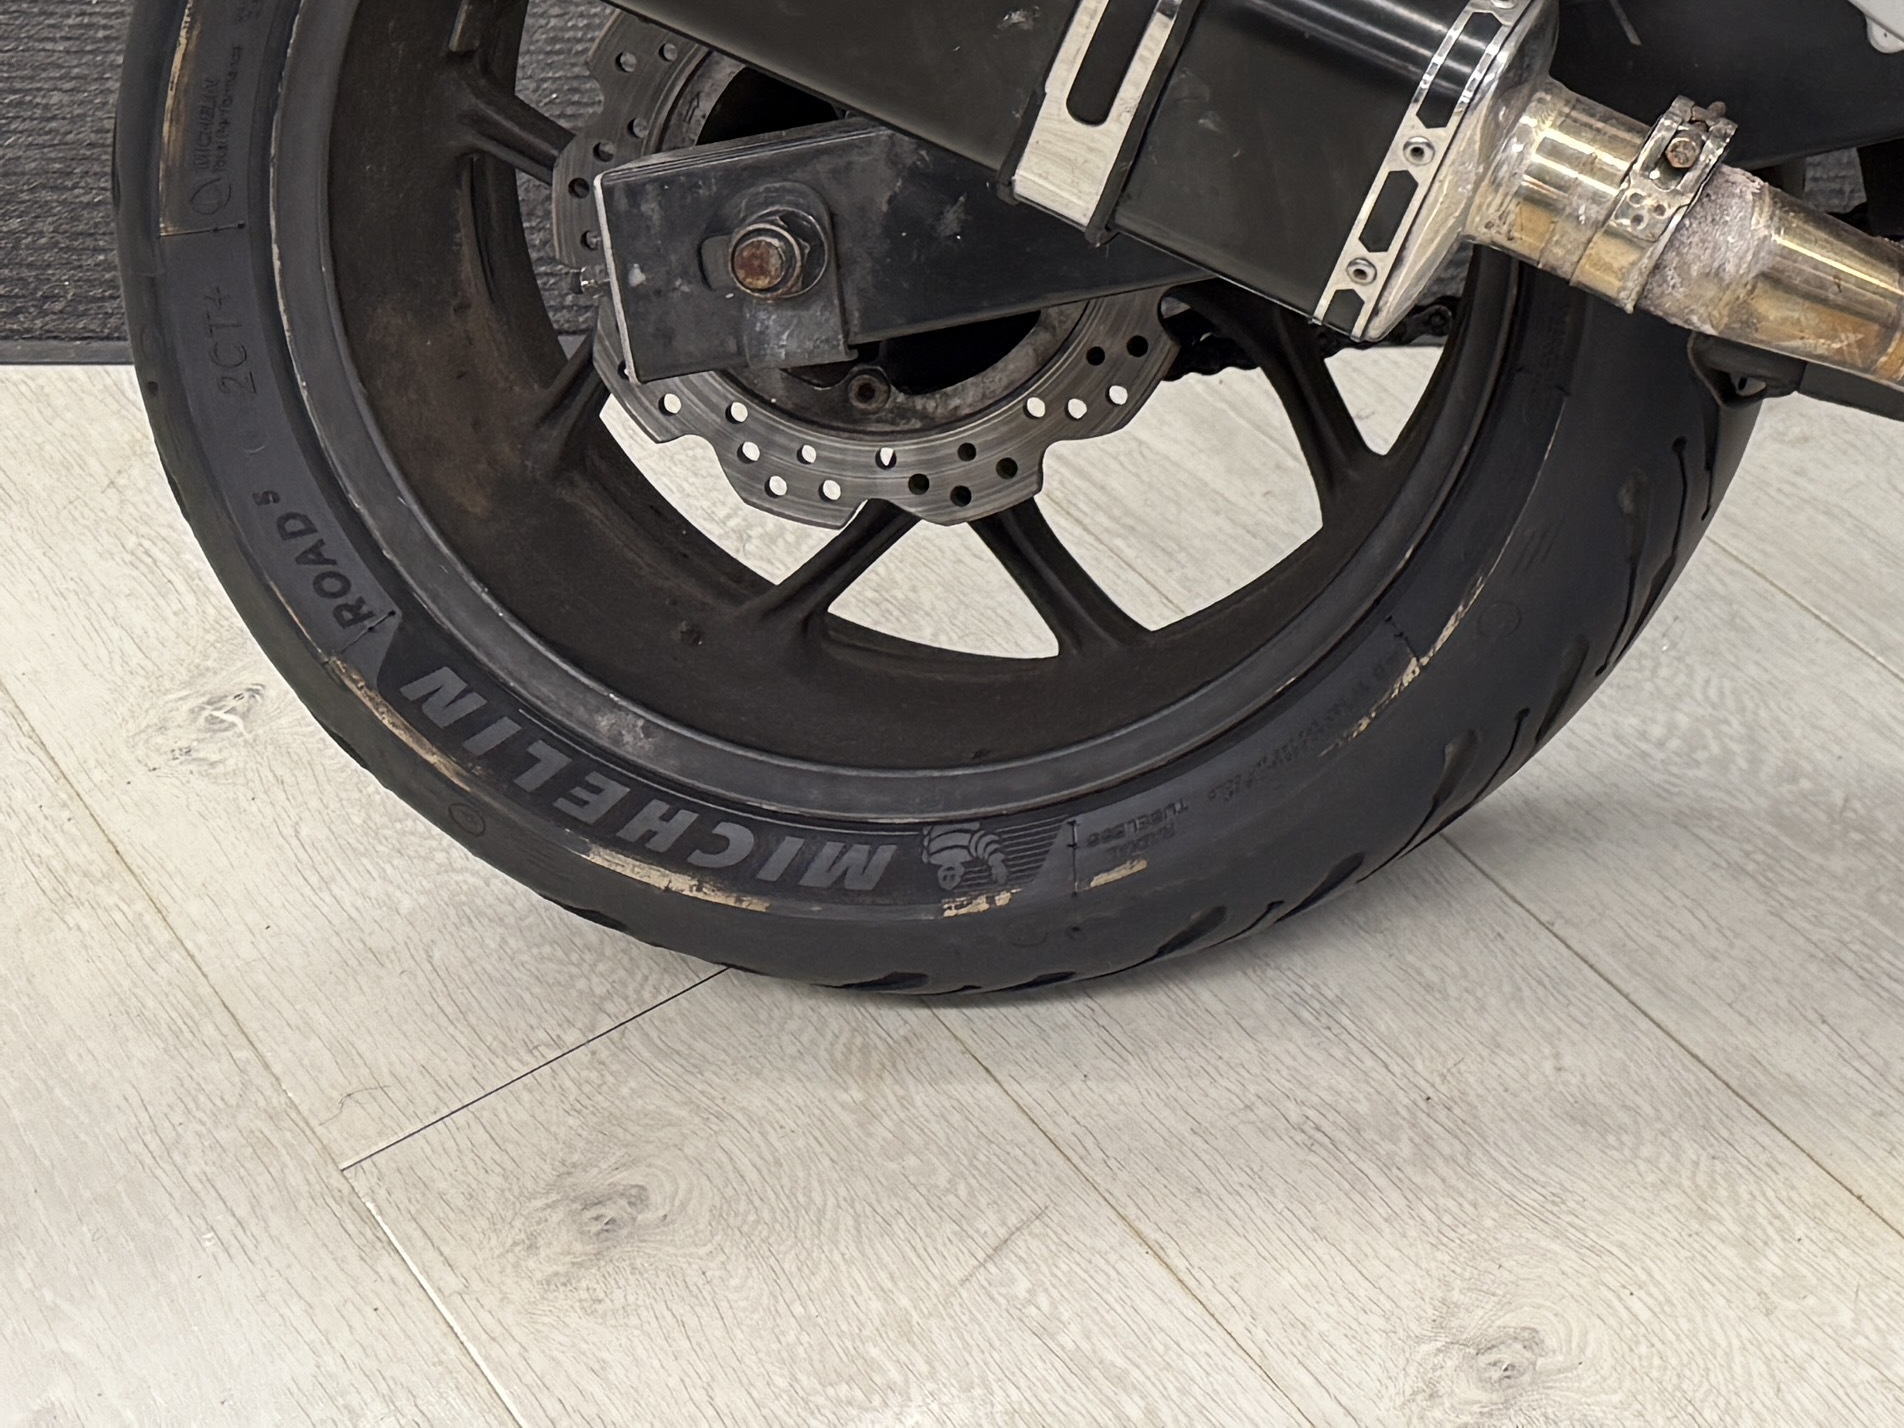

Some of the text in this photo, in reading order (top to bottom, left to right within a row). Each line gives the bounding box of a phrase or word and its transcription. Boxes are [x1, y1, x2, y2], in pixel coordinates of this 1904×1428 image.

[197, 280, 259, 404] 2CT+
[270, 503, 370, 635] ROAD
[395, 651, 899, 892] MICHELIN
